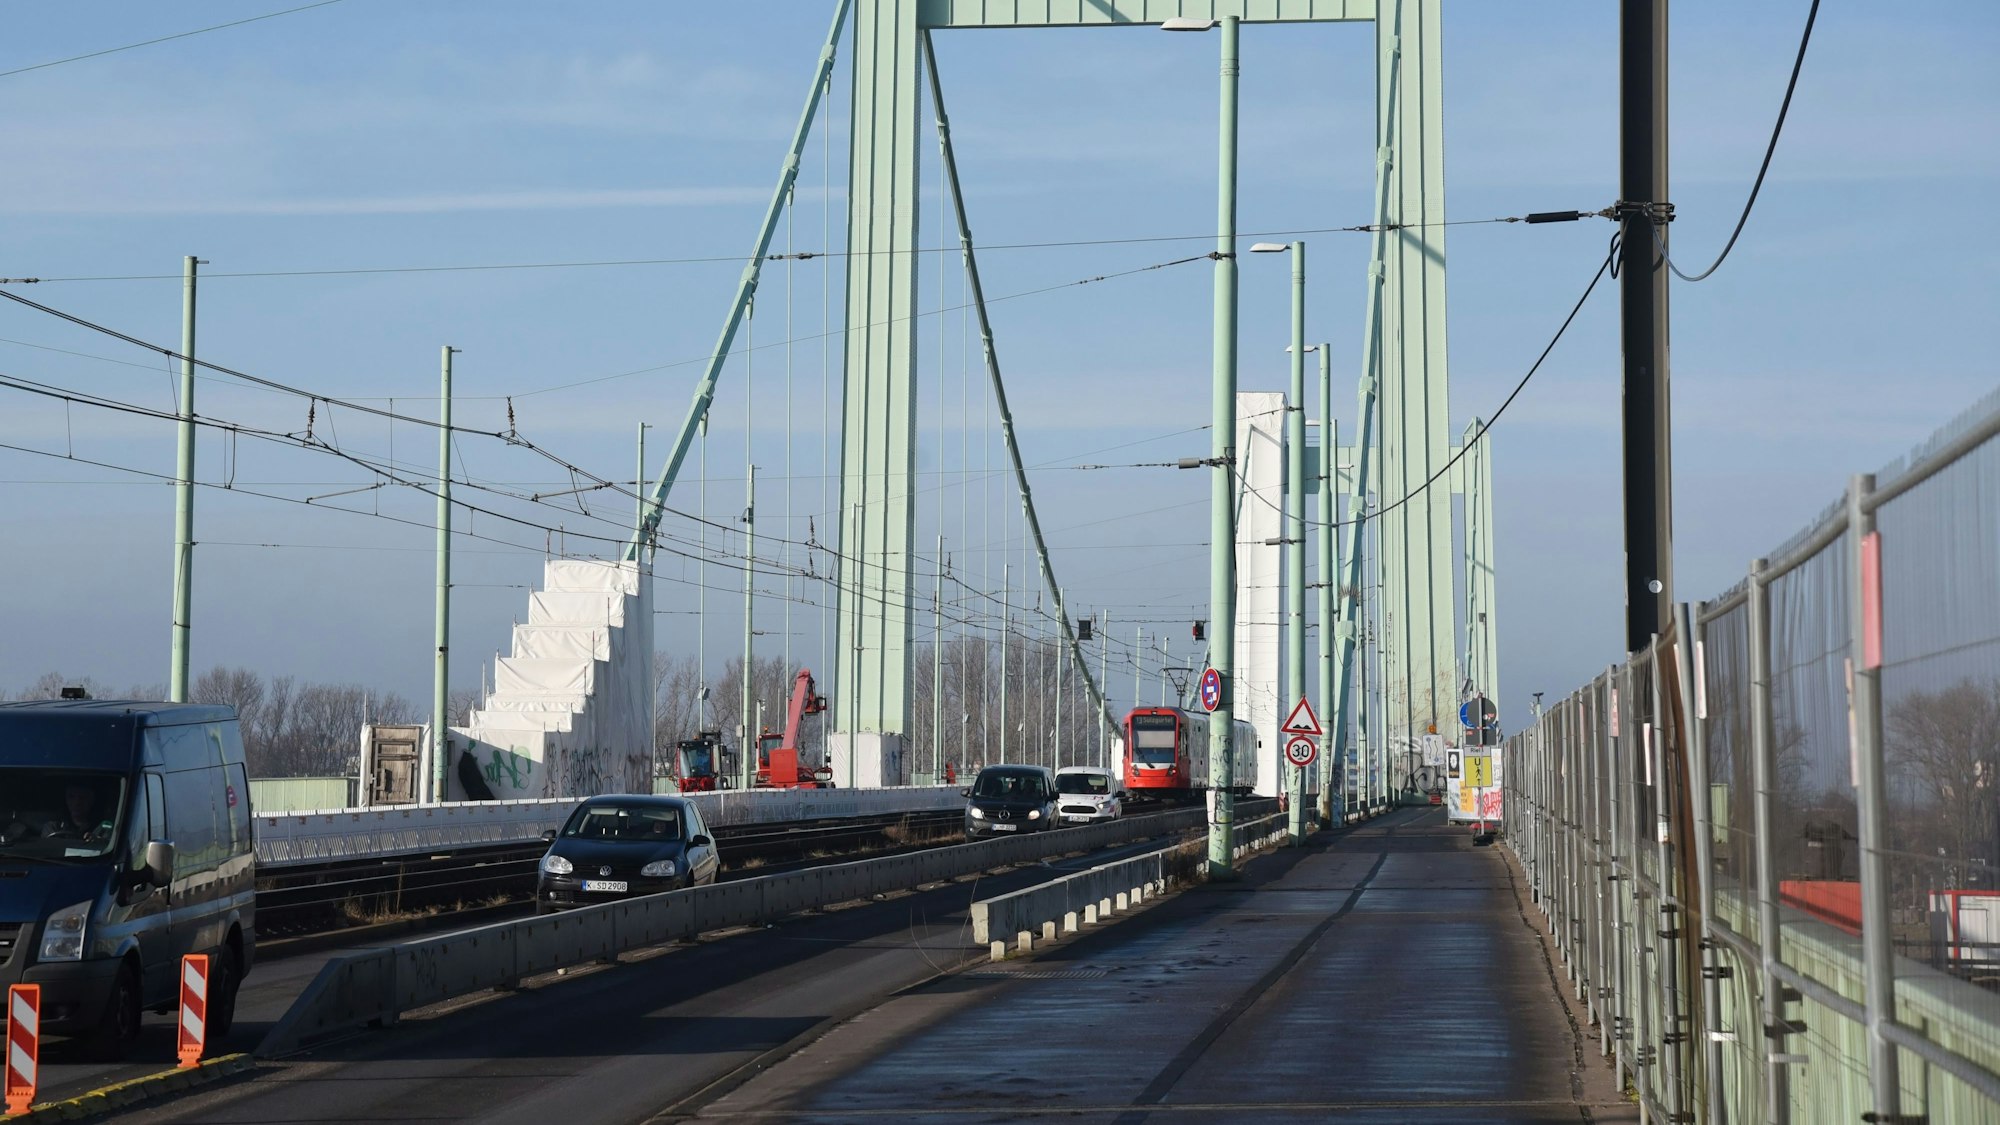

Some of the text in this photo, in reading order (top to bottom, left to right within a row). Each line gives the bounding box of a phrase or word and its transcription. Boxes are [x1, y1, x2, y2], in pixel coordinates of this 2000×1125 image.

[1292, 744, 1310, 758] 30
[1474, 757, 1481, 766] U
[607, 882, 627, 891] 2908
